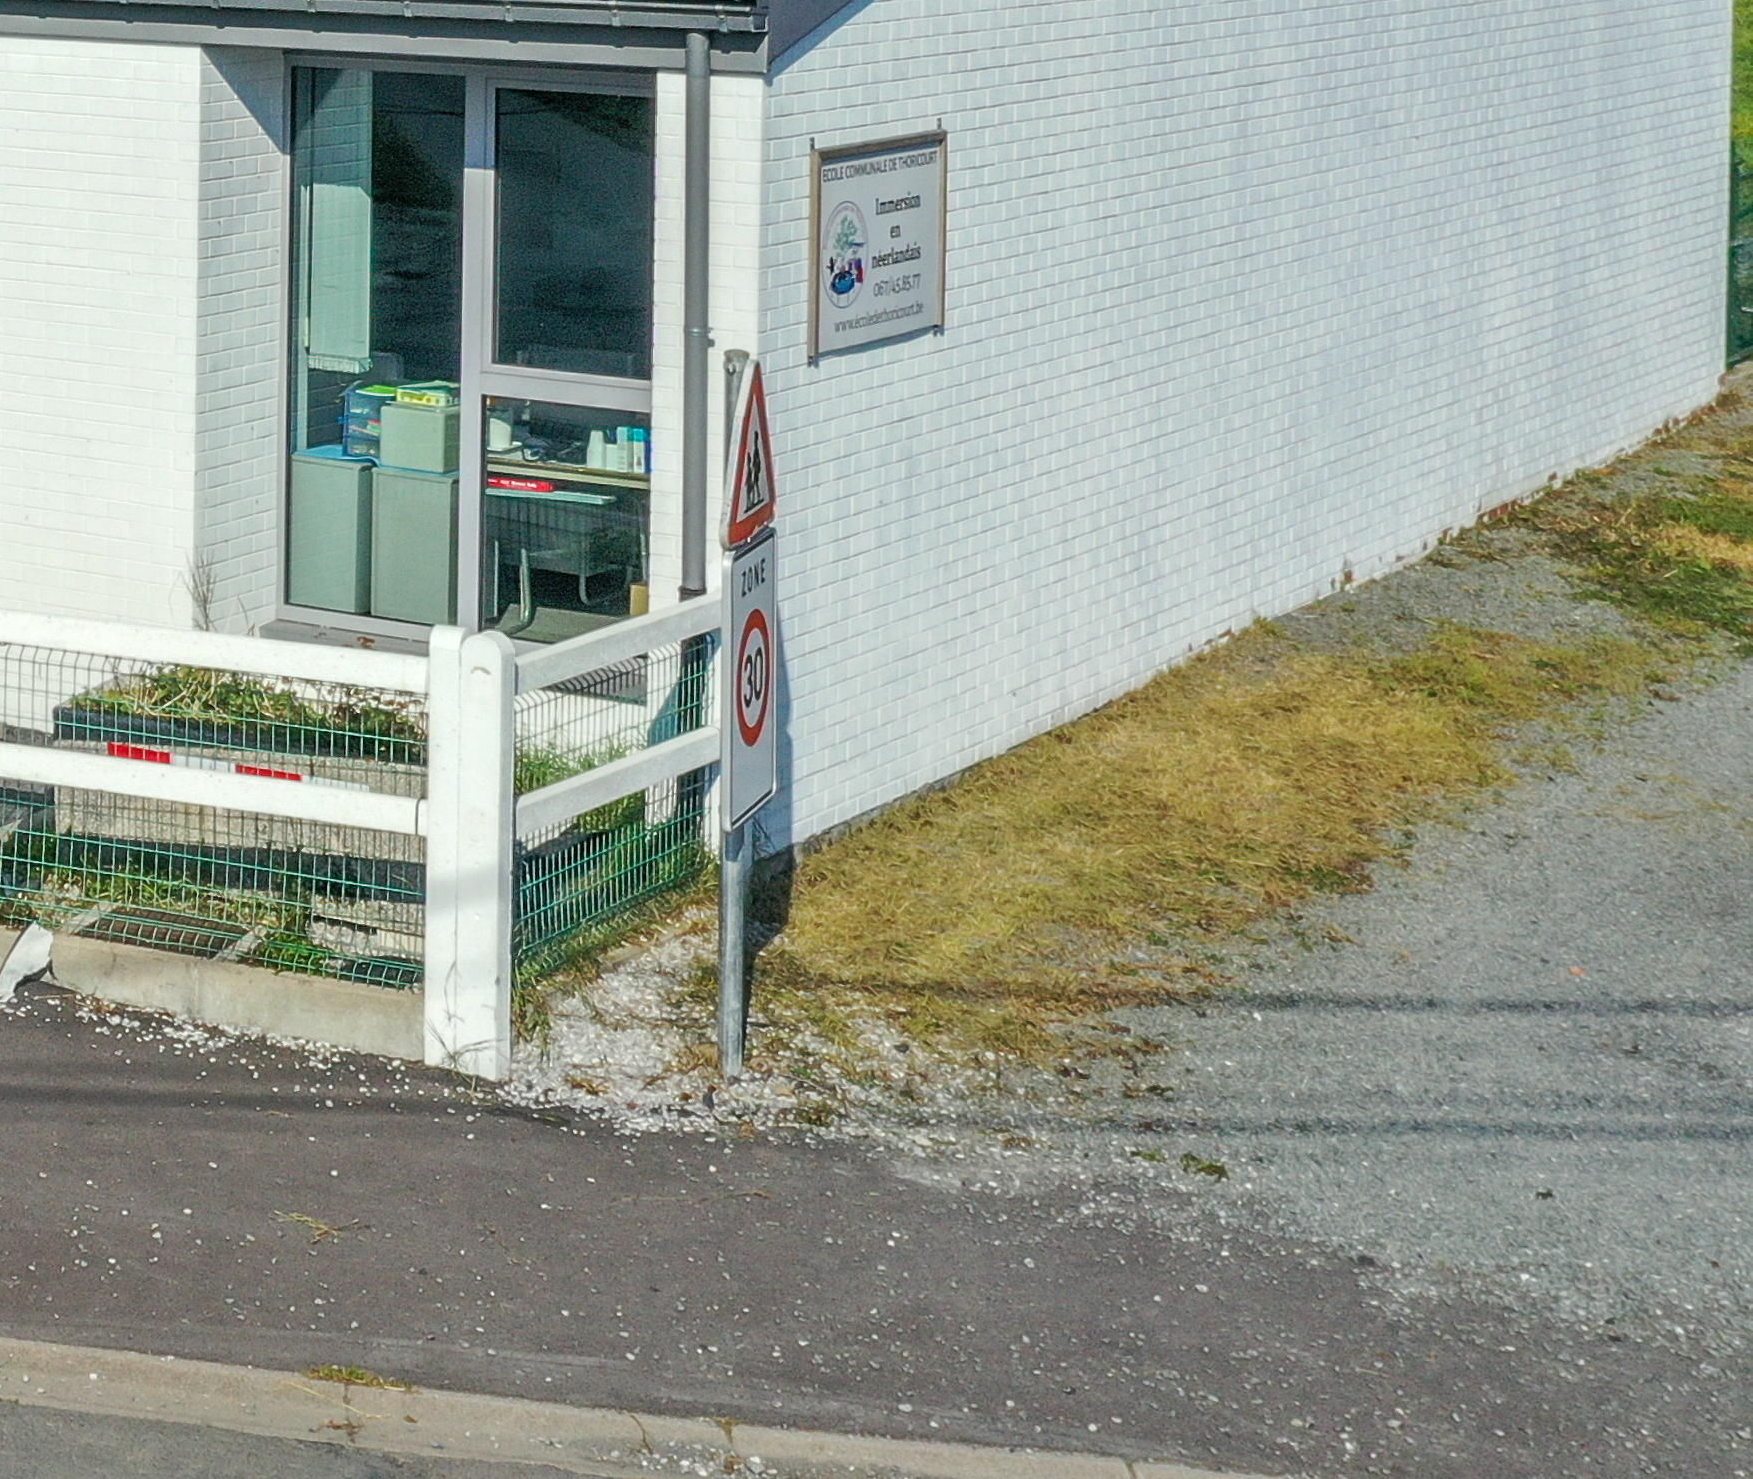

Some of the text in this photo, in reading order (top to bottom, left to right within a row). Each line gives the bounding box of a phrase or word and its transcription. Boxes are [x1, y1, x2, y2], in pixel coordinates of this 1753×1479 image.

[875, 192, 921, 215] Immersion
[890, 224, 901, 239] en
[871, 242, 921, 269] néerlandais
[741, 558, 766, 597] ZONE
[744, 646, 764, 708] 30
